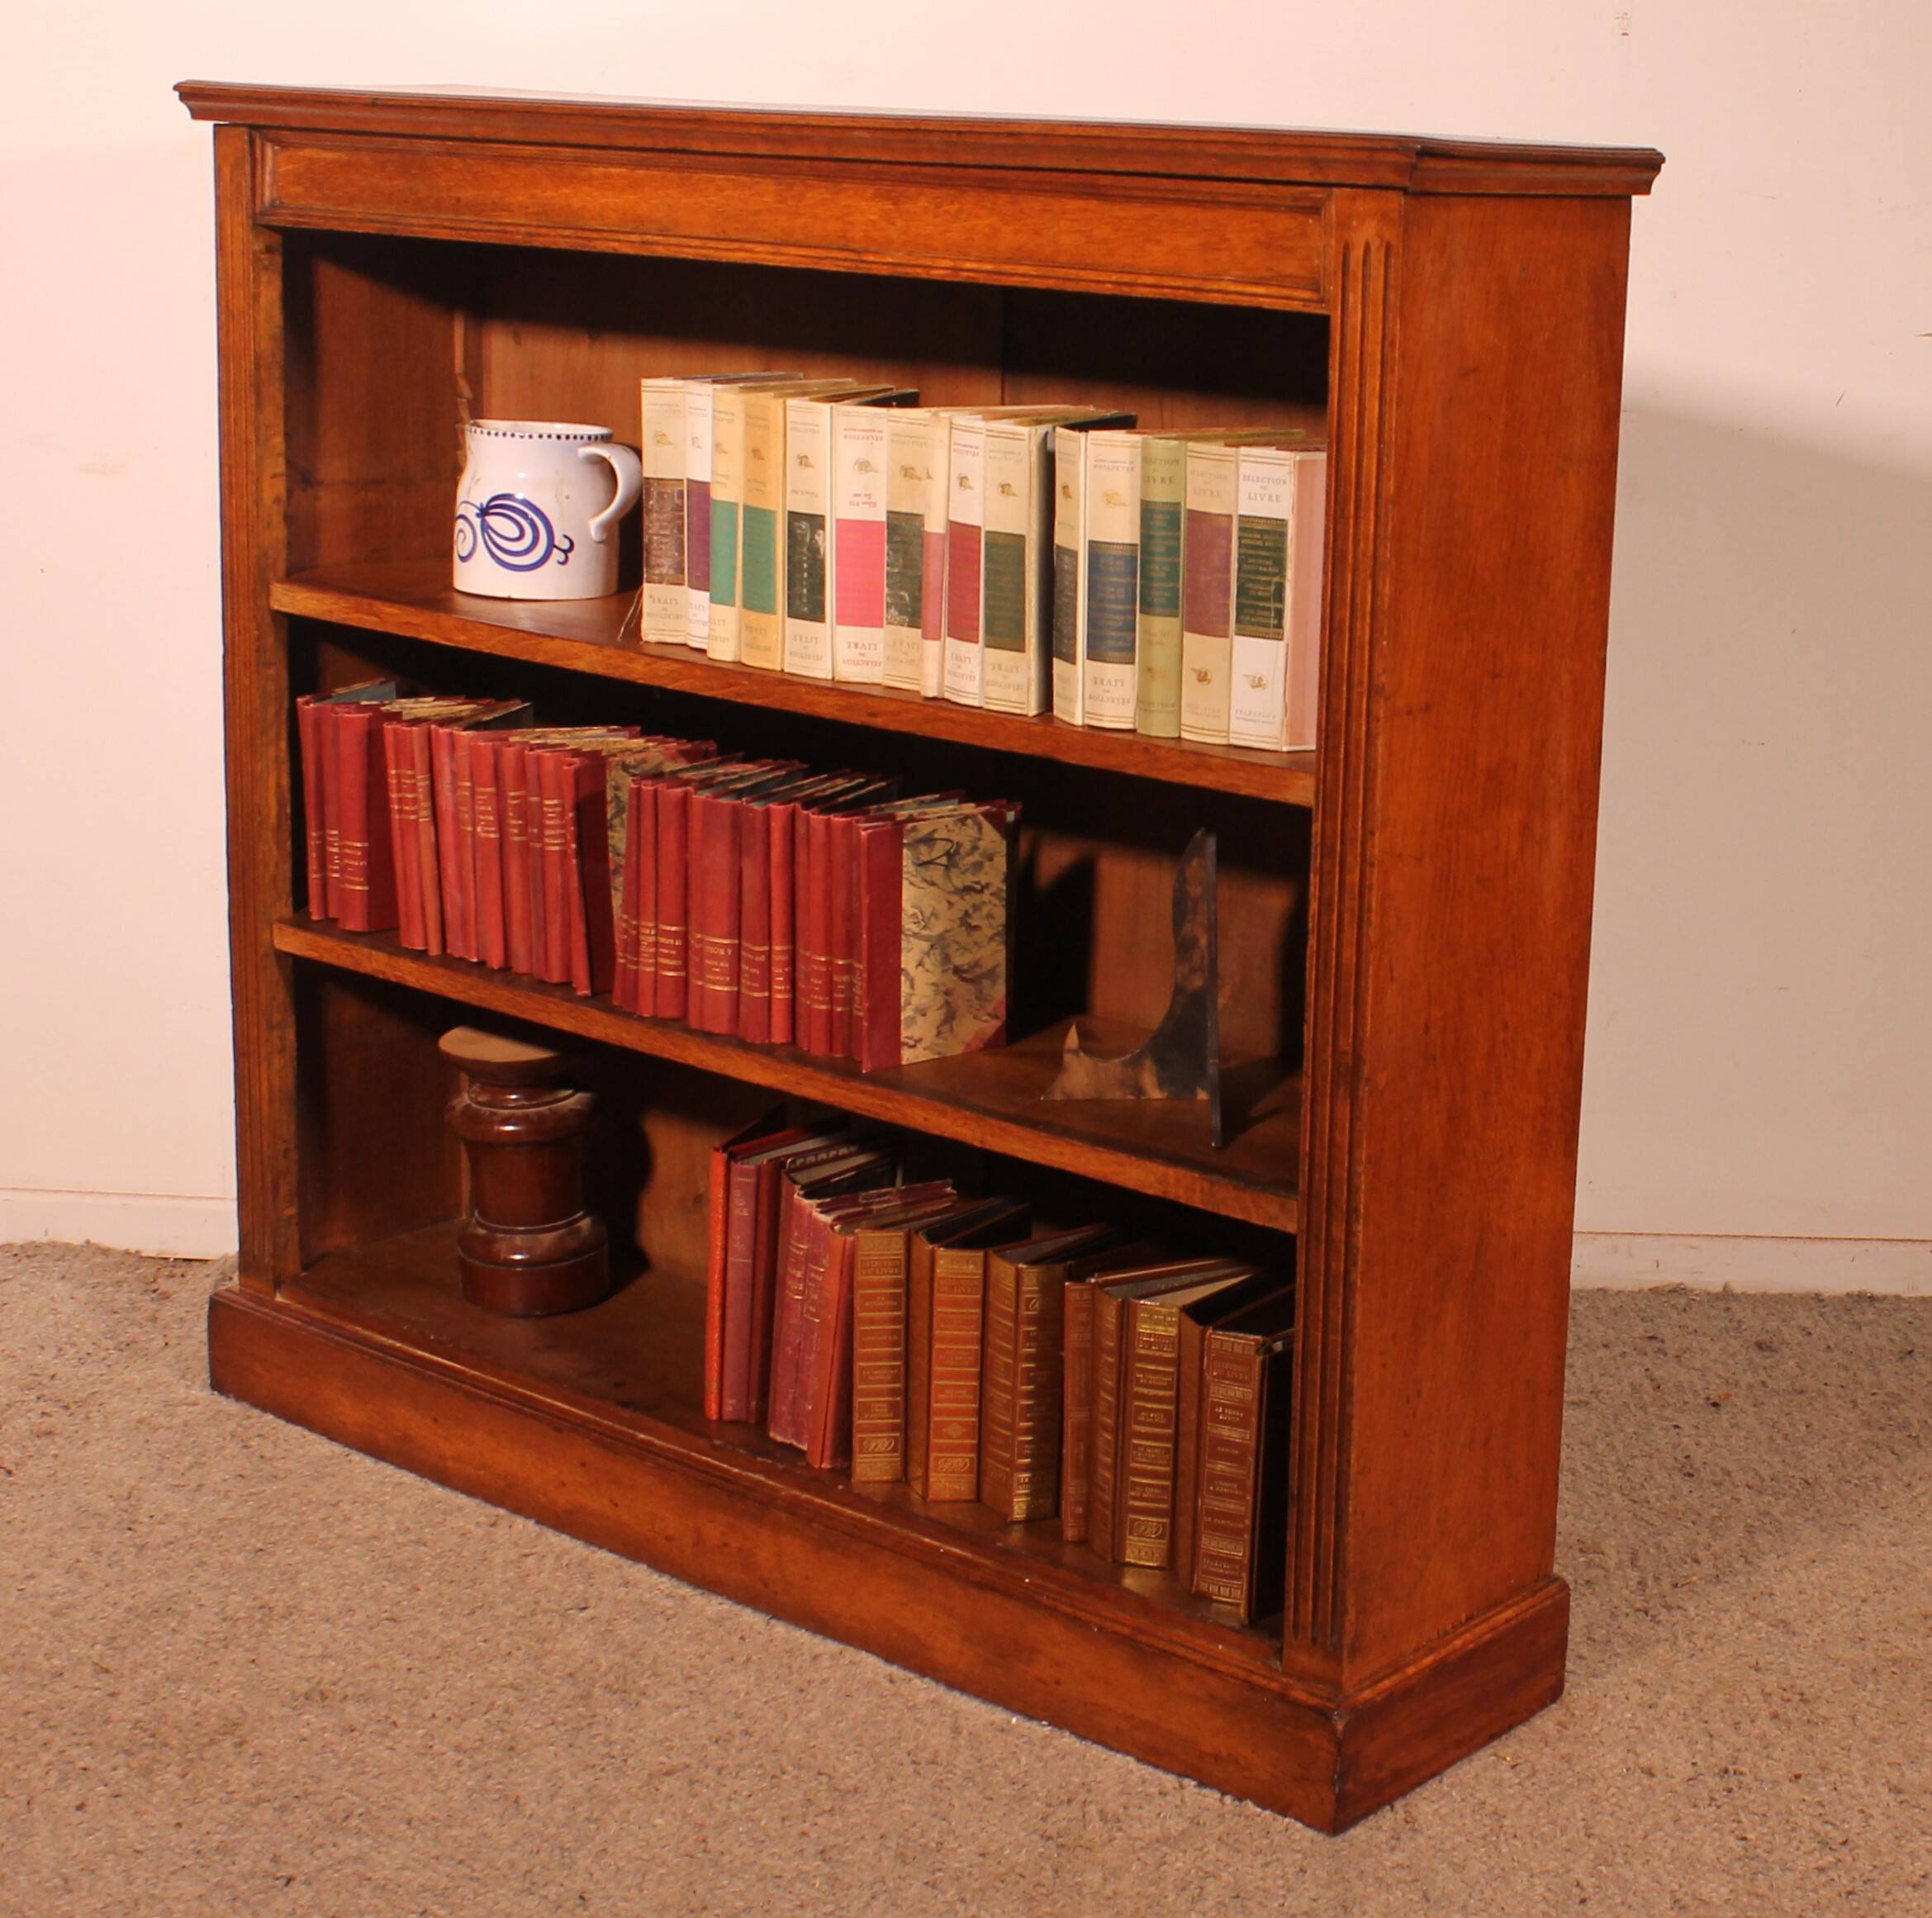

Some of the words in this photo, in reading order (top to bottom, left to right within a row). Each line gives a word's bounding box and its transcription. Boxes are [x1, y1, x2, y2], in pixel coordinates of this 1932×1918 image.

[1247, 492, 1282, 503] LIVRE
[847, 641, 877, 651] LIVRE
[1093, 676, 1124, 687] LIVRE
